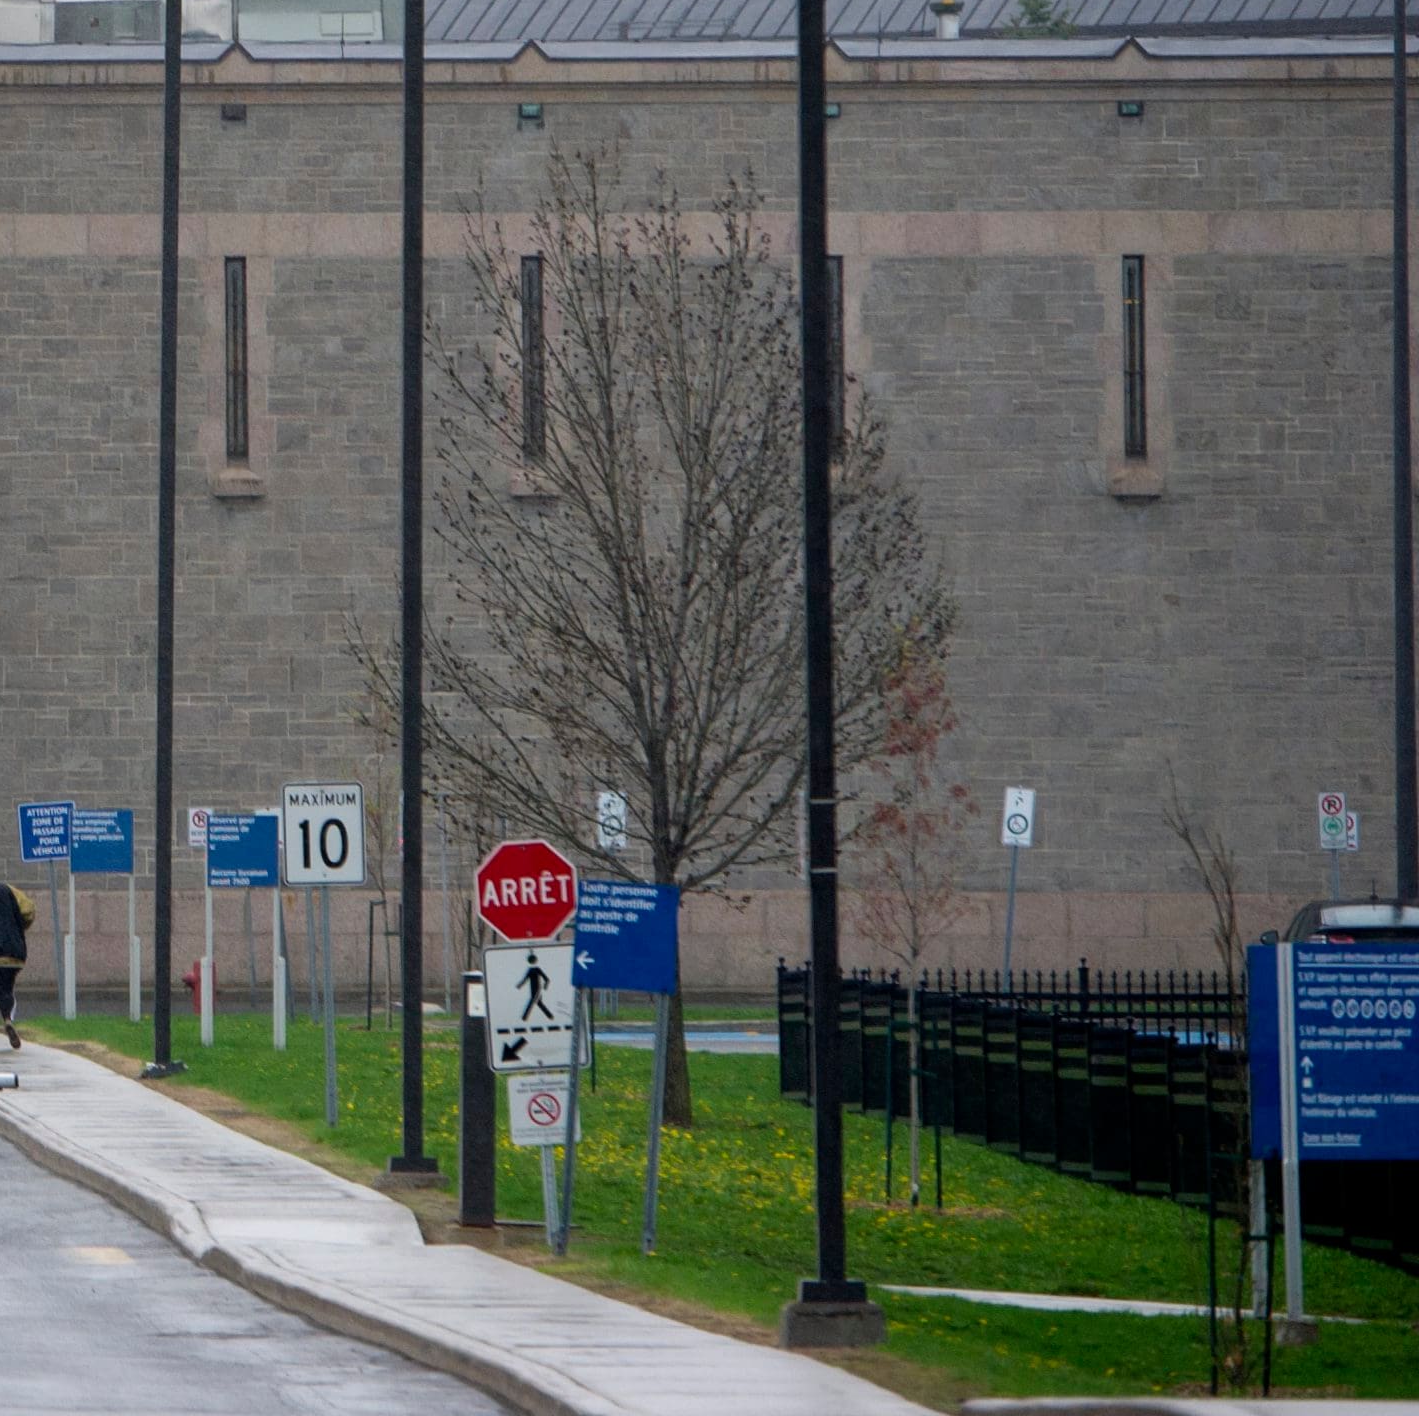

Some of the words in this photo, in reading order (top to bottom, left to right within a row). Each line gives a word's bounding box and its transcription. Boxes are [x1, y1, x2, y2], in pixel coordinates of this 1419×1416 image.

[289, 793, 357, 807] MAXIMUM
[26, 806, 68, 818] ATTENTION
[31, 817, 52, 827] ZONE
[53, 816, 63, 825] DE
[32, 826, 65, 836] PASSAGE
[39, 836, 60, 845] POUR
[298, 818, 349, 869] 10
[32, 845, 68, 856] VÉHICULE
[482, 870, 572, 909] ARRÊT
[580, 881, 610, 894] Toute
[612, 884, 659, 899] personne
[580, 894, 601, 907] doit
[602, 895, 657, 911] s'identifier
[578, 909, 594, 919] au
[595, 911, 623, 925] poste
[624, 911, 639, 923] de
[577, 923, 620, 935] contrôle
